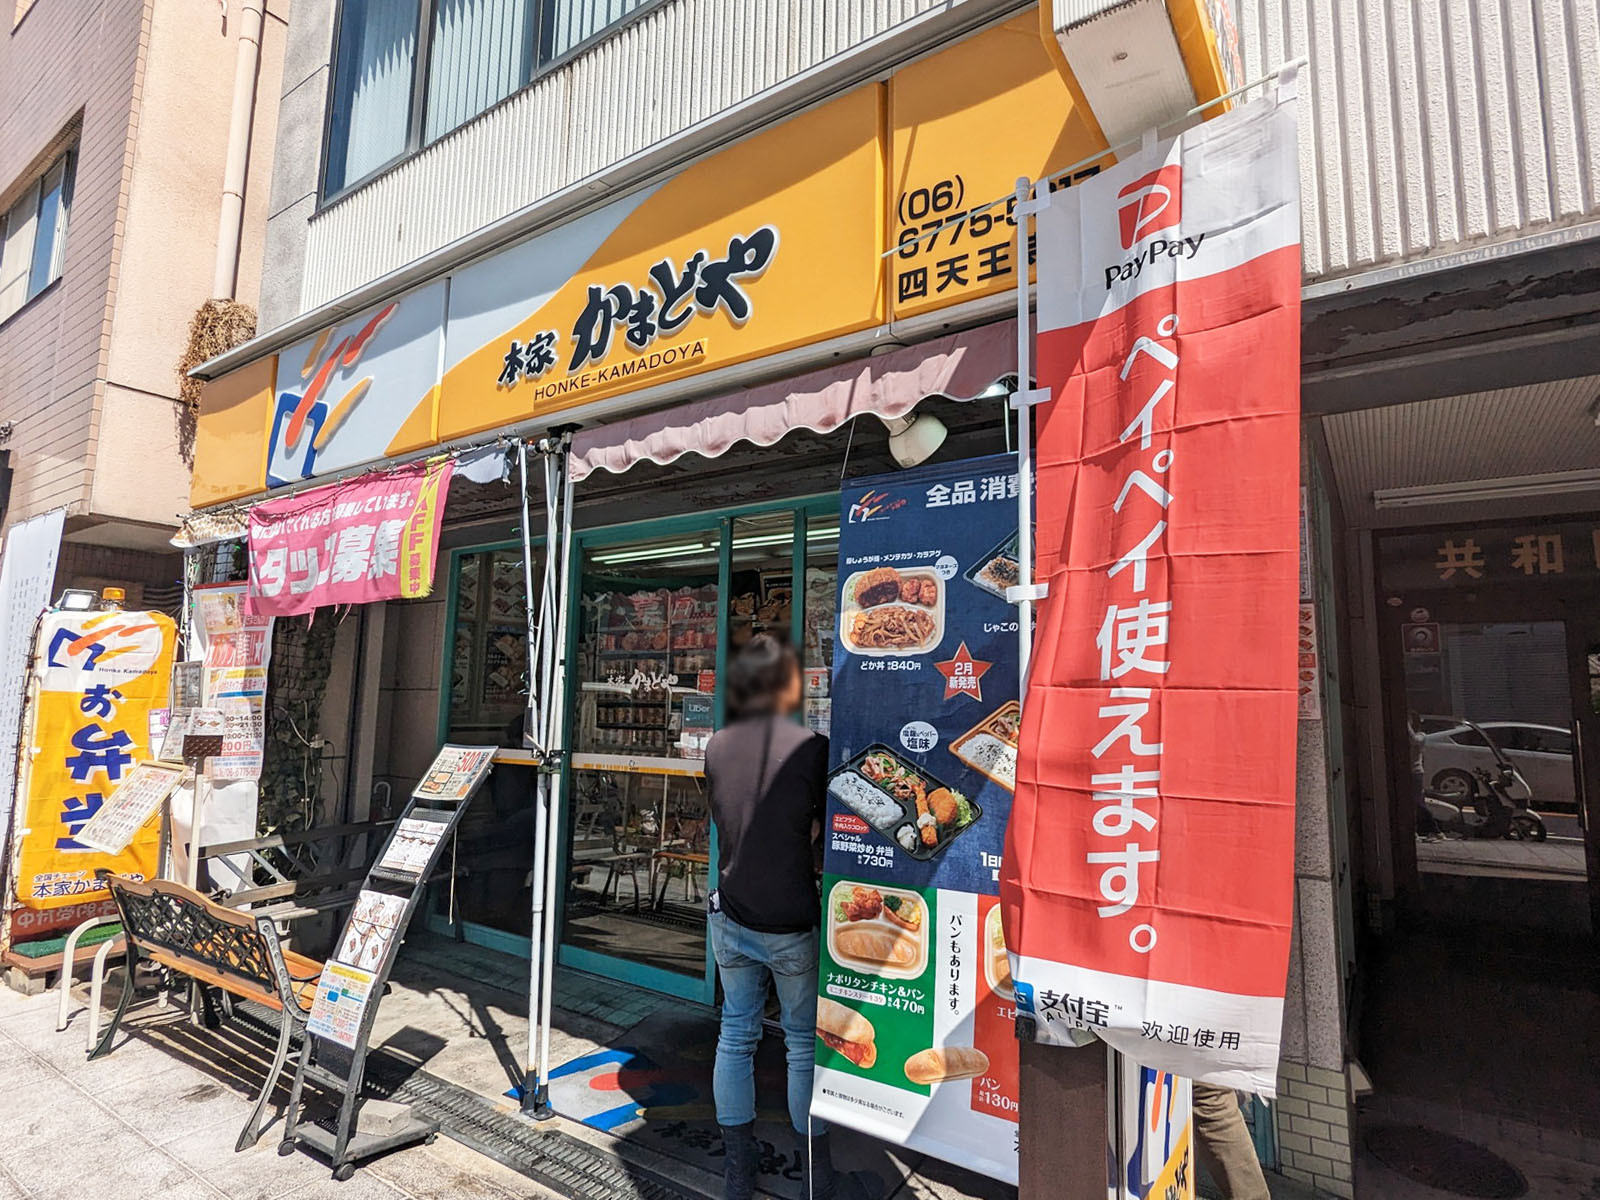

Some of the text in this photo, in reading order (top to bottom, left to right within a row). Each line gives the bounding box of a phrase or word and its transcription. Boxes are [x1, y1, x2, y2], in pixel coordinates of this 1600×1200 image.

[898, 174, 964, 226] (06)
[1105, 232, 1206, 291] PayPay
[496, 226, 777, 386] 本家 かまどや
[533, 340, 706, 402] HONKE-KAMADOYA
[925, 478, 977, 509] 全品
[1435, 528, 1600, 581] 共和
[1086, 313, 1181, 954] ペイペイ使えます。
[949, 675, 977, 689] 新発売
[954, 662, 973, 676] 2月
[906, 737, 931, 750] 塩味
[831, 832, 862, 842] スペシャル
[948, 913, 963, 1016] パンもあります。
[1039, 989, 1110, 1028] 支付宝
[1141, 1020, 1241, 1051] 欢迎使用
[979, 1077, 1001, 1091] パン
